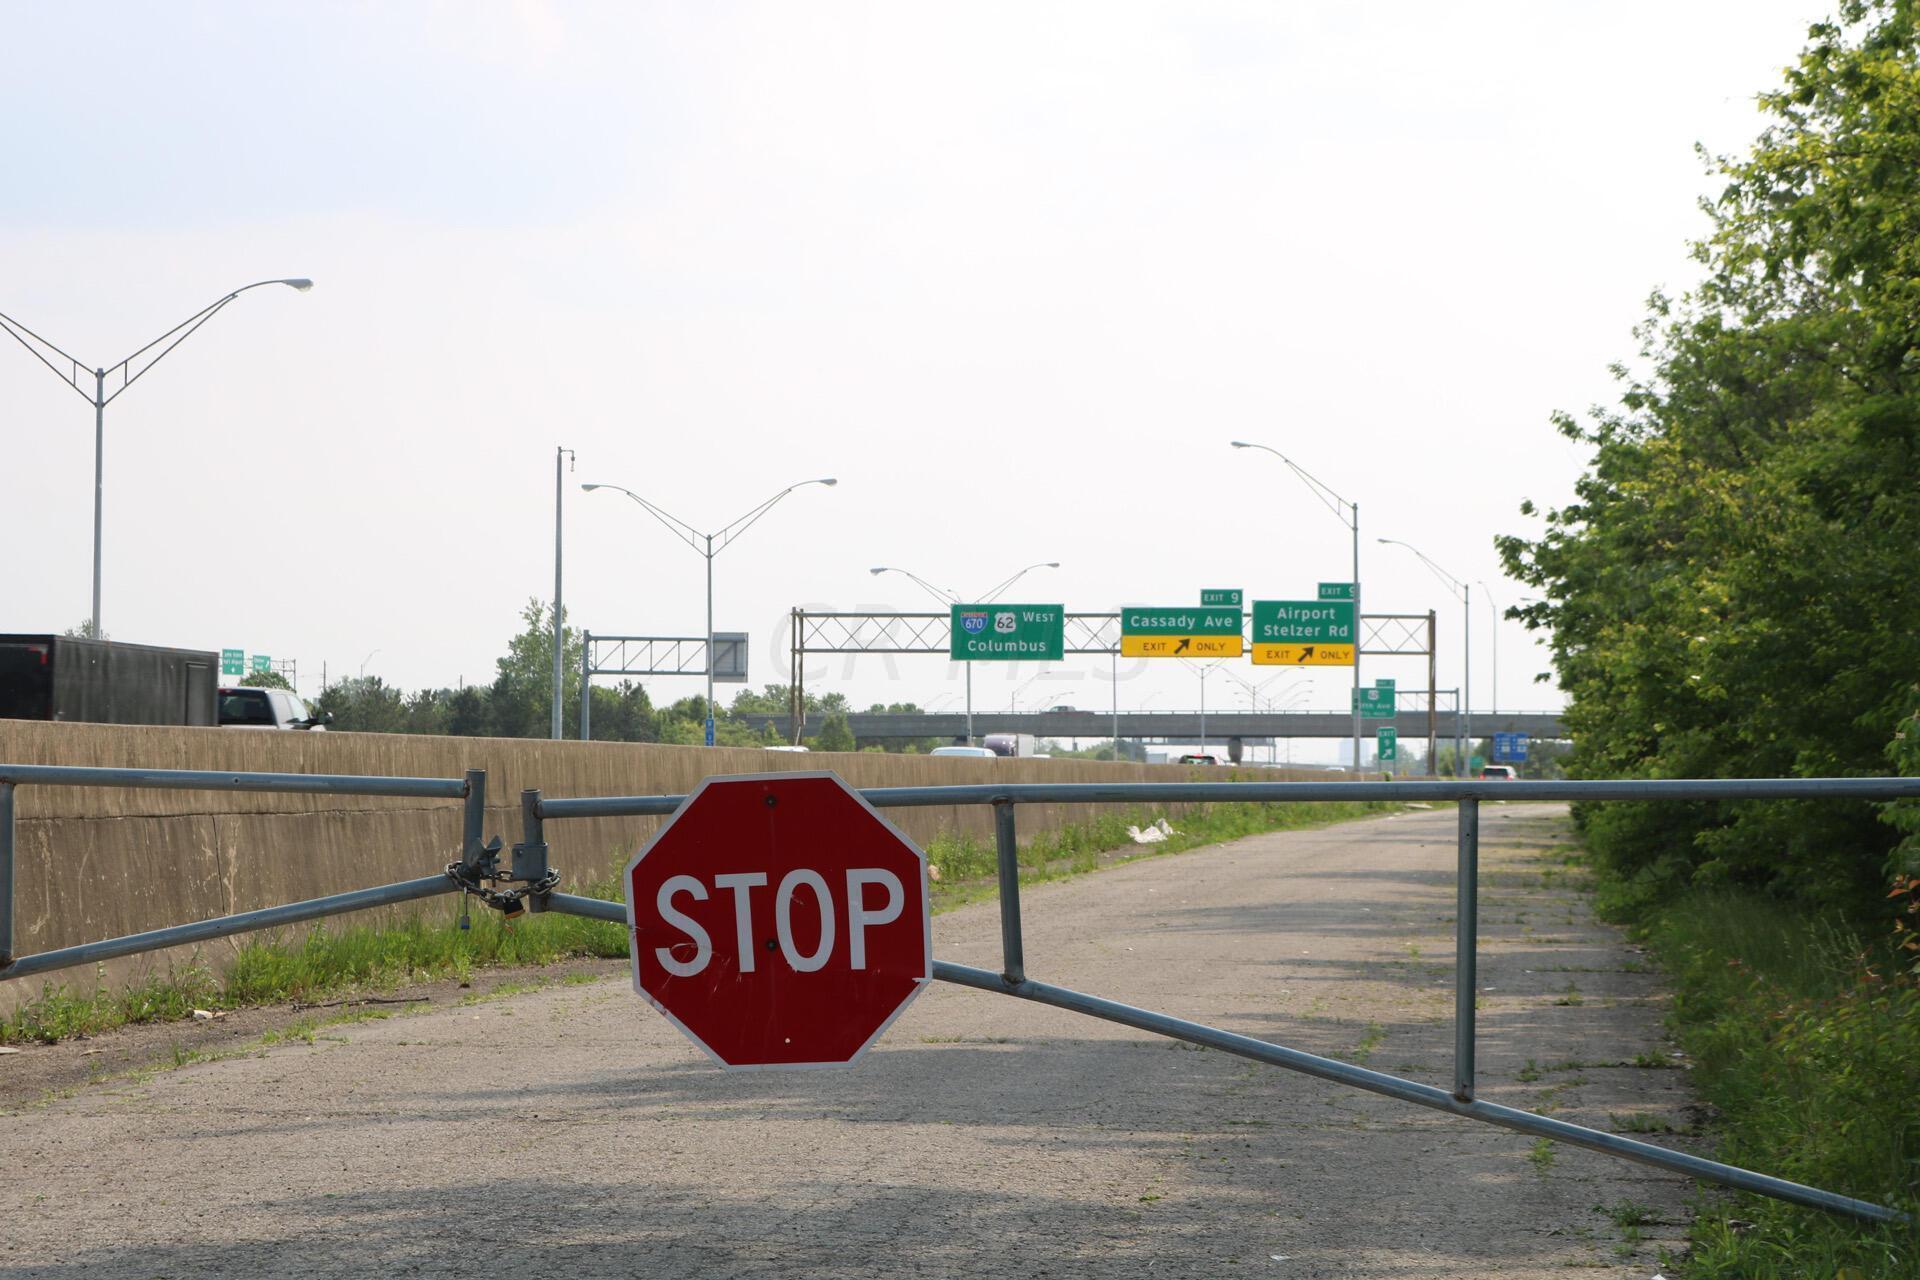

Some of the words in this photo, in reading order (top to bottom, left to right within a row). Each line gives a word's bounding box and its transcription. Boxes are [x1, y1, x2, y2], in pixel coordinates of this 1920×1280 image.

[1321, 587, 1341, 595] EXIT
[1231, 592, 1239, 603] 9
[1022, 611, 1055, 622] WEST
[1277, 607, 1336, 621] Airport
[965, 618, 983, 629] 670
[997, 617, 1014, 628] 62
[1130, 615, 1196, 629] Cassady
[1204, 615, 1233, 627] Ave
[1263, 624, 1321, 636] Stelzer
[1329, 625, 1348, 636] Rd
[967, 640, 1046, 652] Columbus
[1143, 642, 1167, 651] EXIT
[1196, 642, 1226, 651] ONLY
[1265, 650, 1290, 659] EXIT
[1320, 651, 1350, 660] ONLY
[655, 867, 905, 977] STOP
